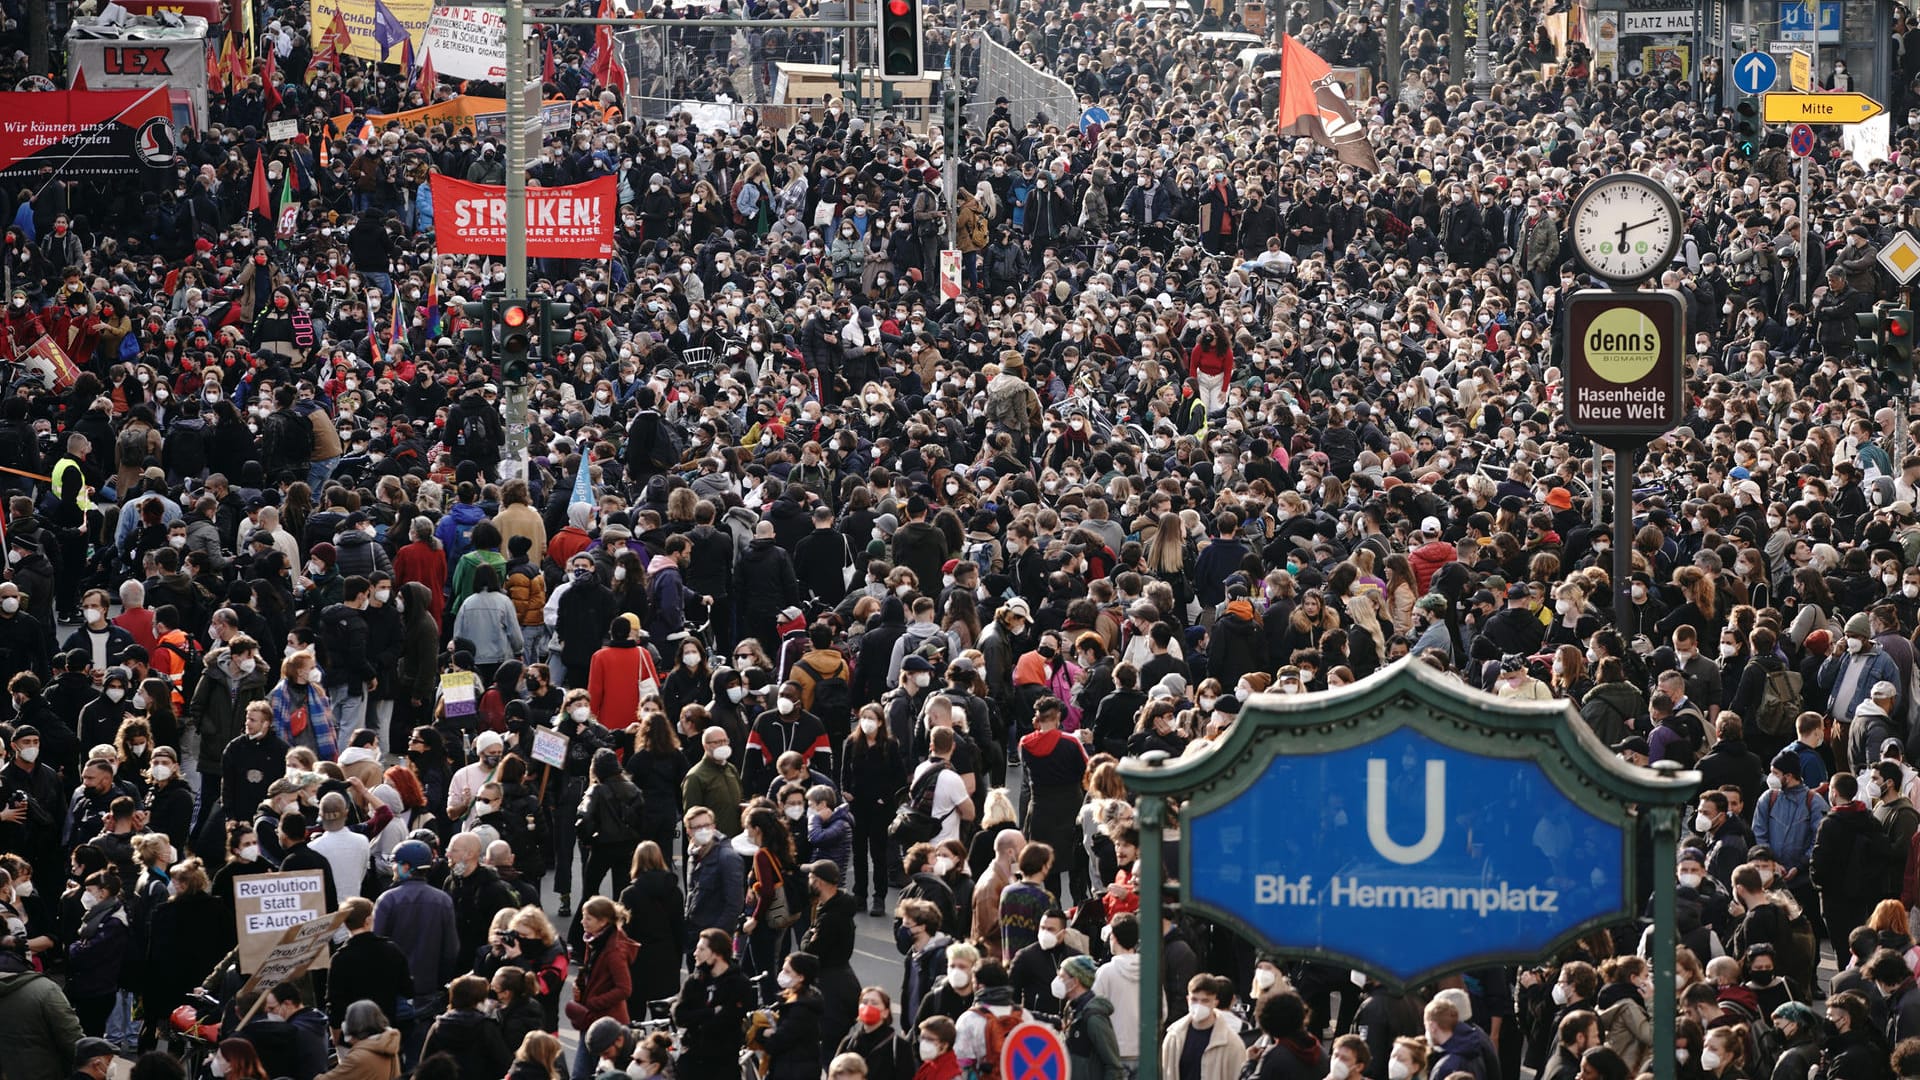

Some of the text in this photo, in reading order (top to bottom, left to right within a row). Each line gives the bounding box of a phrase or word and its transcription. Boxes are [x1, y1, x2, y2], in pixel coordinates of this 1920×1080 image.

[463, 9, 477, 22] DIE
[1628, 17, 1662, 28] PLATZ
[104, 47, 173, 75] LEX
[1802, 102, 1833, 114] Mitte
[4, 122, 27, 132] Wir
[30, 120, 76, 132] können
[81, 122, 104, 132] uns
[23, 133, 110, 147] selbst befreien
[454, 197, 601, 226] STRIKEN!
[1578, 387, 1665, 402] Hasenheide
[1578, 404, 1665, 419] Neue Welt
[1367, 758, 1445, 865] U
[240, 879, 318, 896] Revolution
[1254, 874, 1559, 917] Bhf. Hermannplatz
[264, 897, 295, 910] statt
[249, 912, 313, 930] E-Autos!
